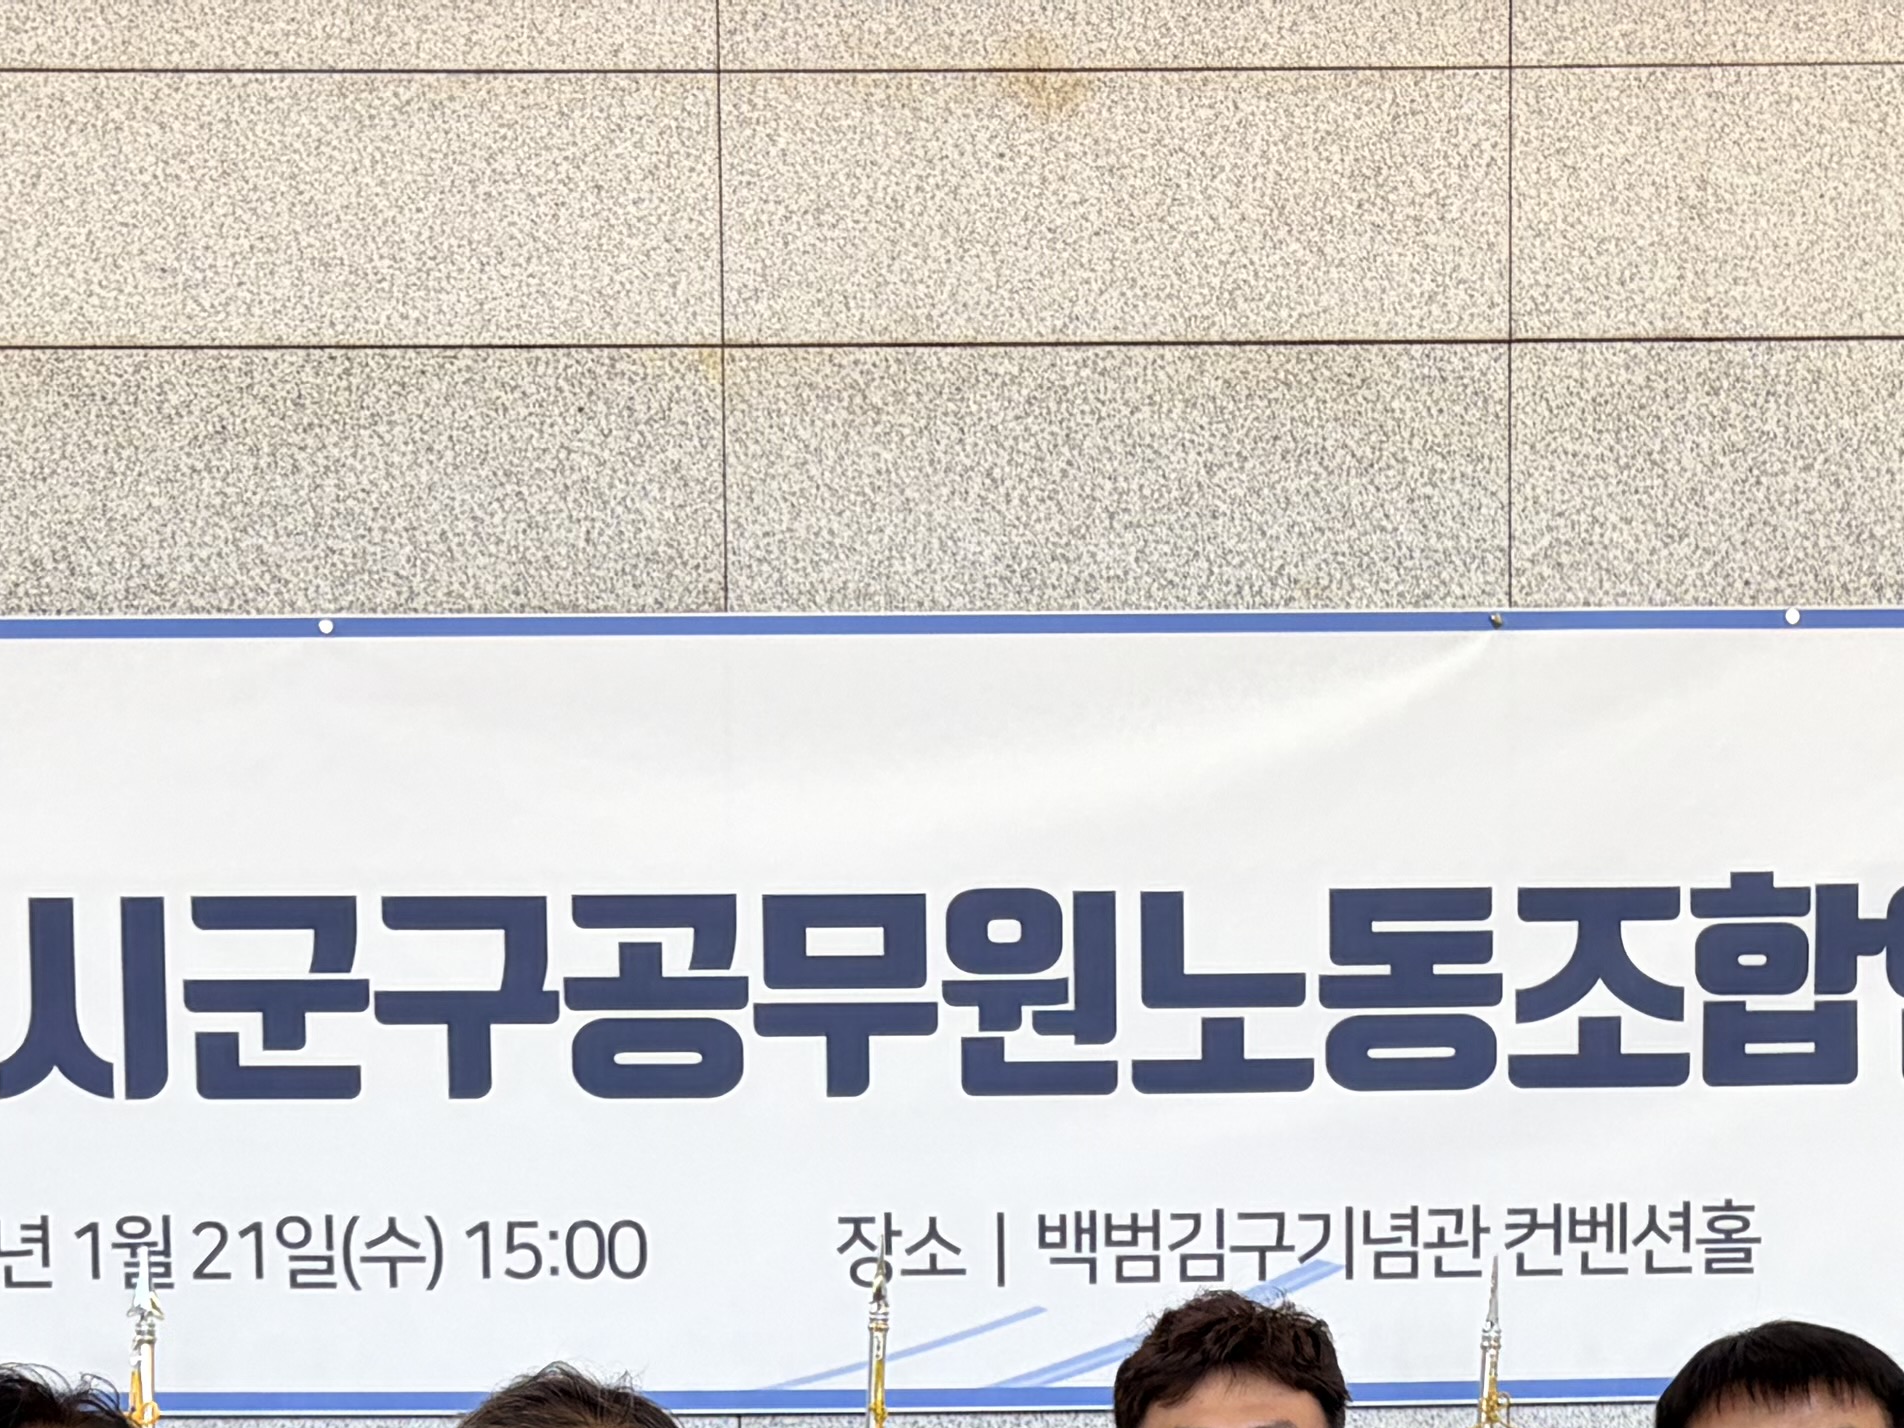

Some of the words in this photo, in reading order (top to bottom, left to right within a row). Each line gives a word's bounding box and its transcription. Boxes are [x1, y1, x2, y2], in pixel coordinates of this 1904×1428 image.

[74, 1213, 175, 1290] 1월
[191, 1213, 444, 1291] 21일(수)
[465, 1219, 648, 1280] 15:00
[836, 1211, 966, 1288] 장소
[1036, 1203, 1492, 1284] 백범김구기념관
[1501, 1199, 1763, 1278] 컨벤션홀
